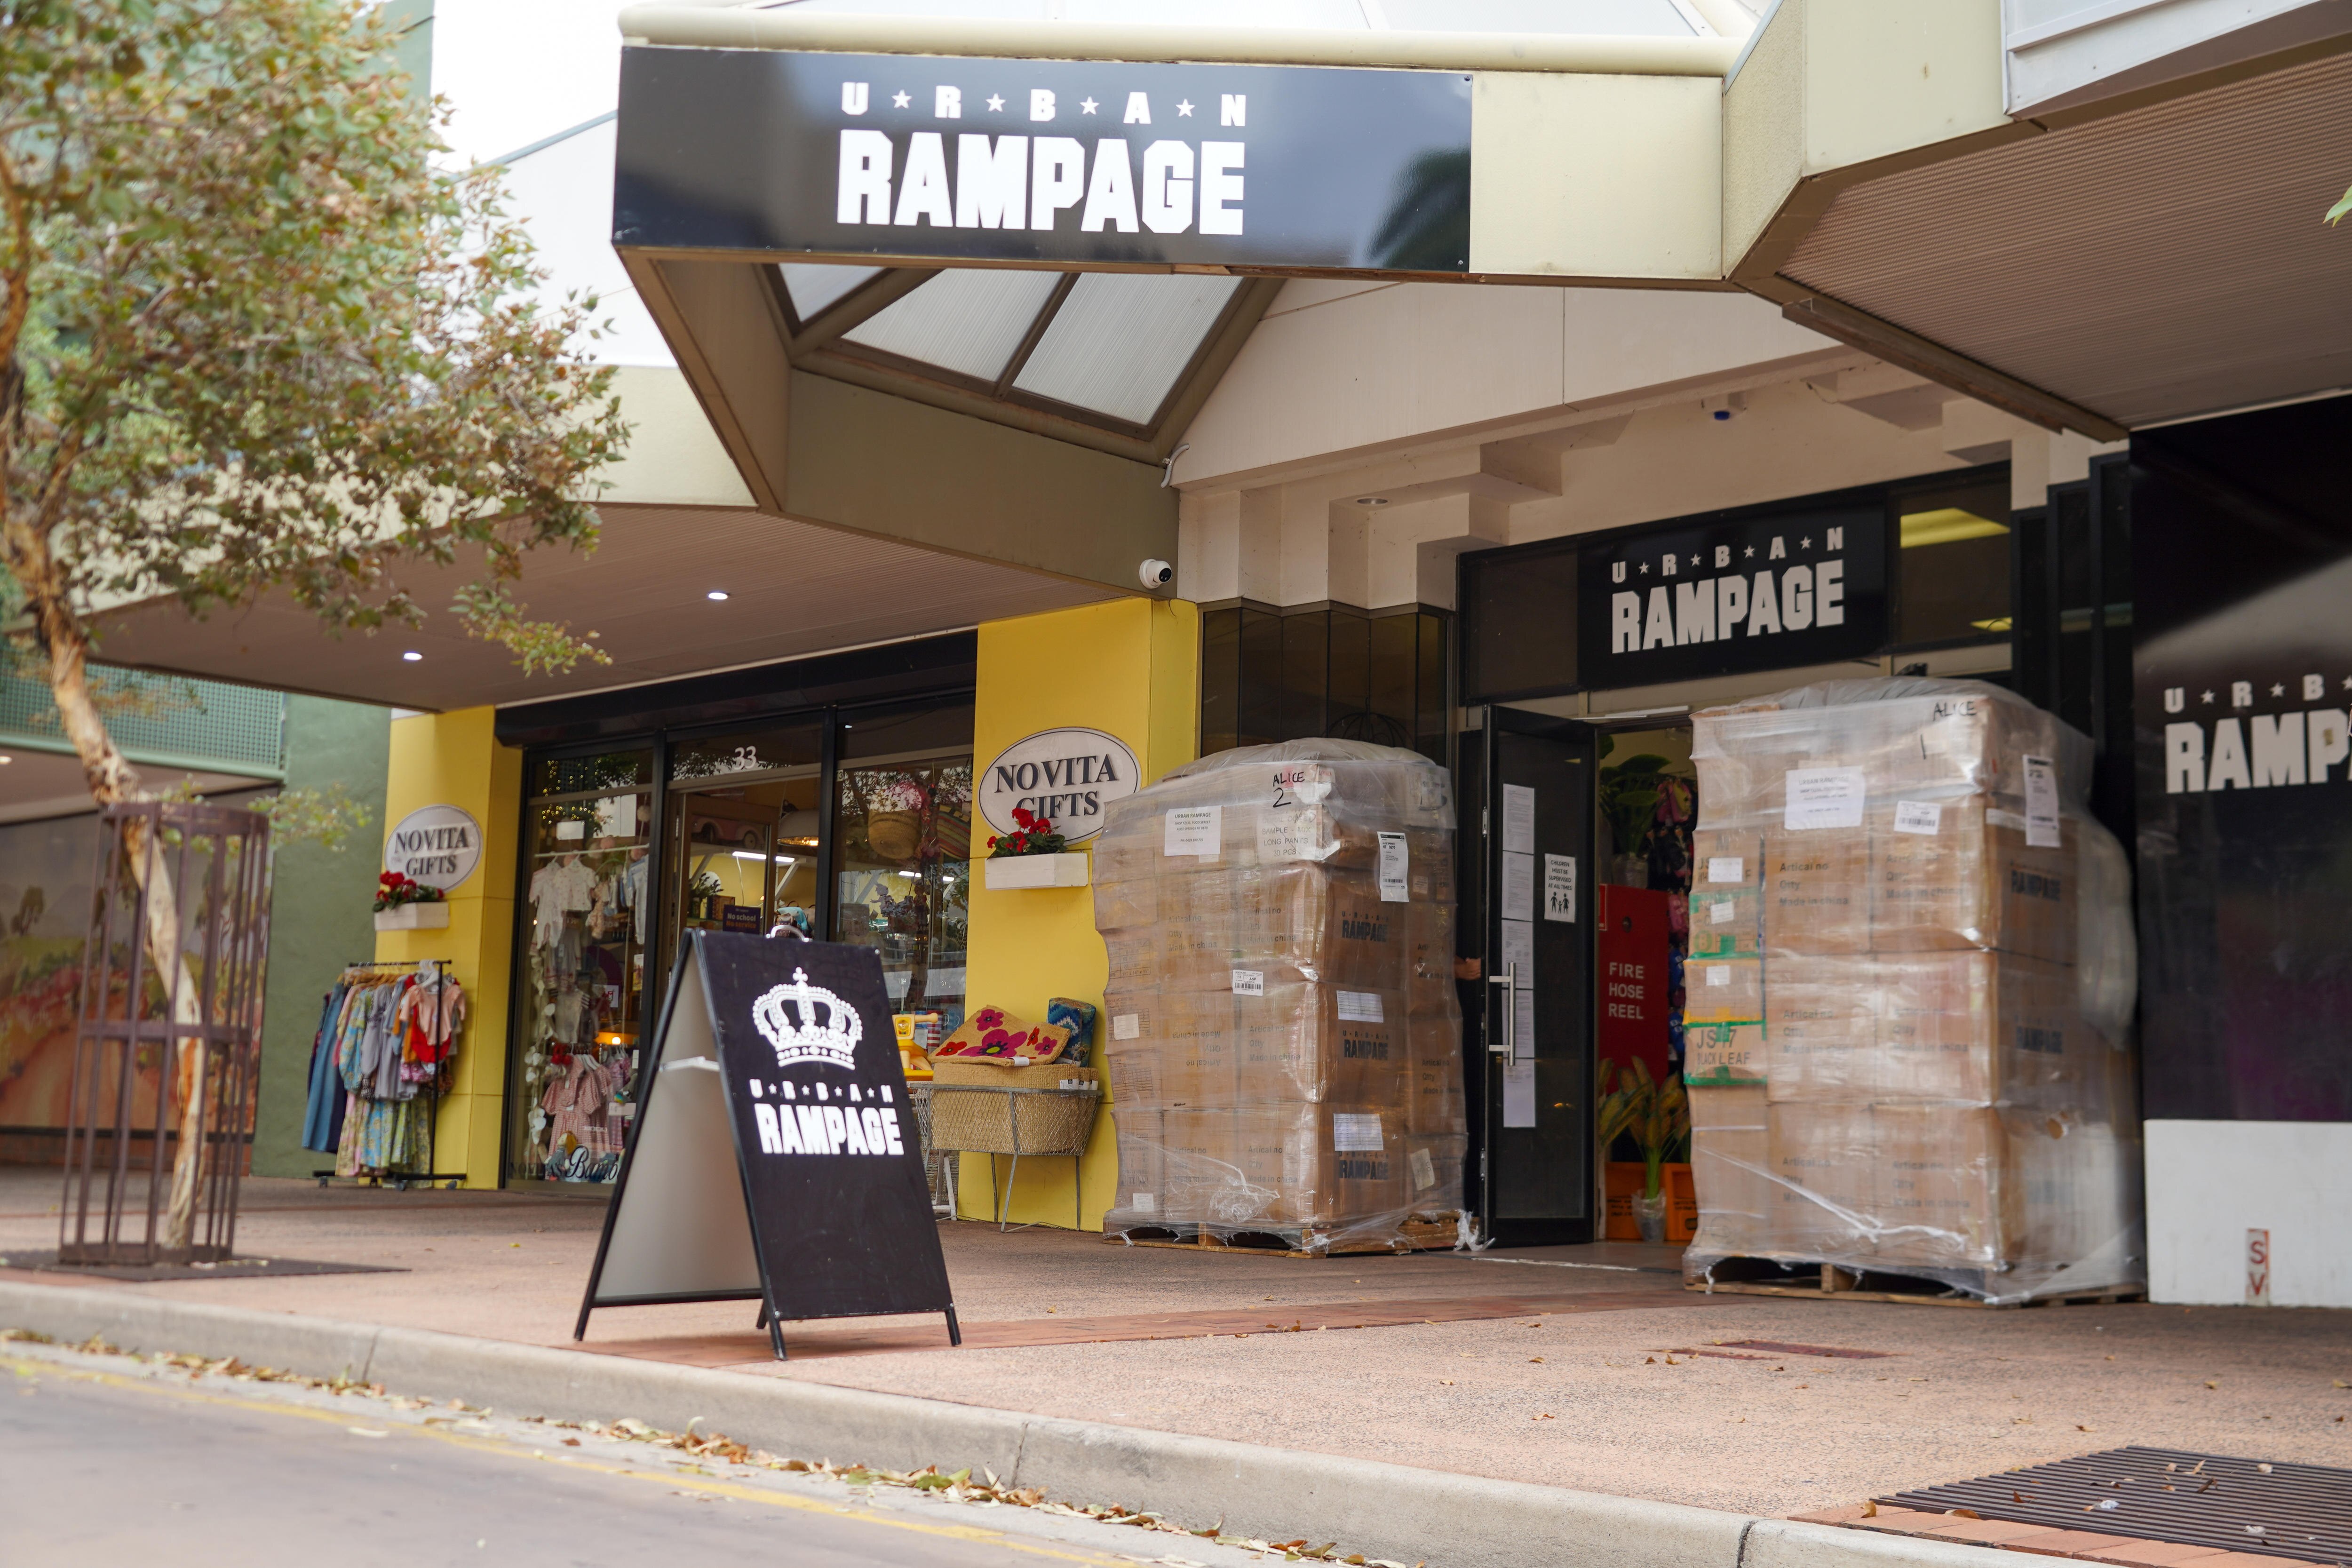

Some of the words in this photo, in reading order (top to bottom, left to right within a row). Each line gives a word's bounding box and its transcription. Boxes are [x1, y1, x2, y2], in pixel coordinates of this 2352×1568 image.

[841, 82, 1246, 127] URBAN
[837, 129, 1246, 235] RAMPAGE
[1612, 526, 1844, 584] URBAN
[1612, 559, 1844, 654] RAMPAGE
[1933, 701, 1978, 721] ALICE
[734, 745, 756, 770] 33
[2165, 708, 2352, 794] RAMP
[994, 754, 1118, 793] NOVITA
[1273, 772, 1305, 787] ALICE
[1016, 791, 1099, 820] GIFTS
[1272, 788, 1291, 808] 2
[394, 826, 469, 854] NOVITA
[1262, 827, 1288, 835] SAMPLE
[405, 854, 457, 876] GIFTS
[1779, 897, 1805, 907] Made
[1342, 919, 1388, 942] RAMPAGE
[1168, 943, 1186, 952] Made
[1609, 962, 1644, 979] FIRE
[1609, 982, 1644, 999] HOSE
[1608, 1003, 1644, 1019] REEL
[1344, 1039, 1388, 1060] RAMPAGE
[1718, 1051, 1750, 1065] LEAF
[1197, 1059, 1221, 1067] Artical
[749, 1078, 893, 1103] URBAN
[754, 1103, 905, 1155] RAMPAGE
[1339, 1159, 1388, 1180] RAMPAGE
